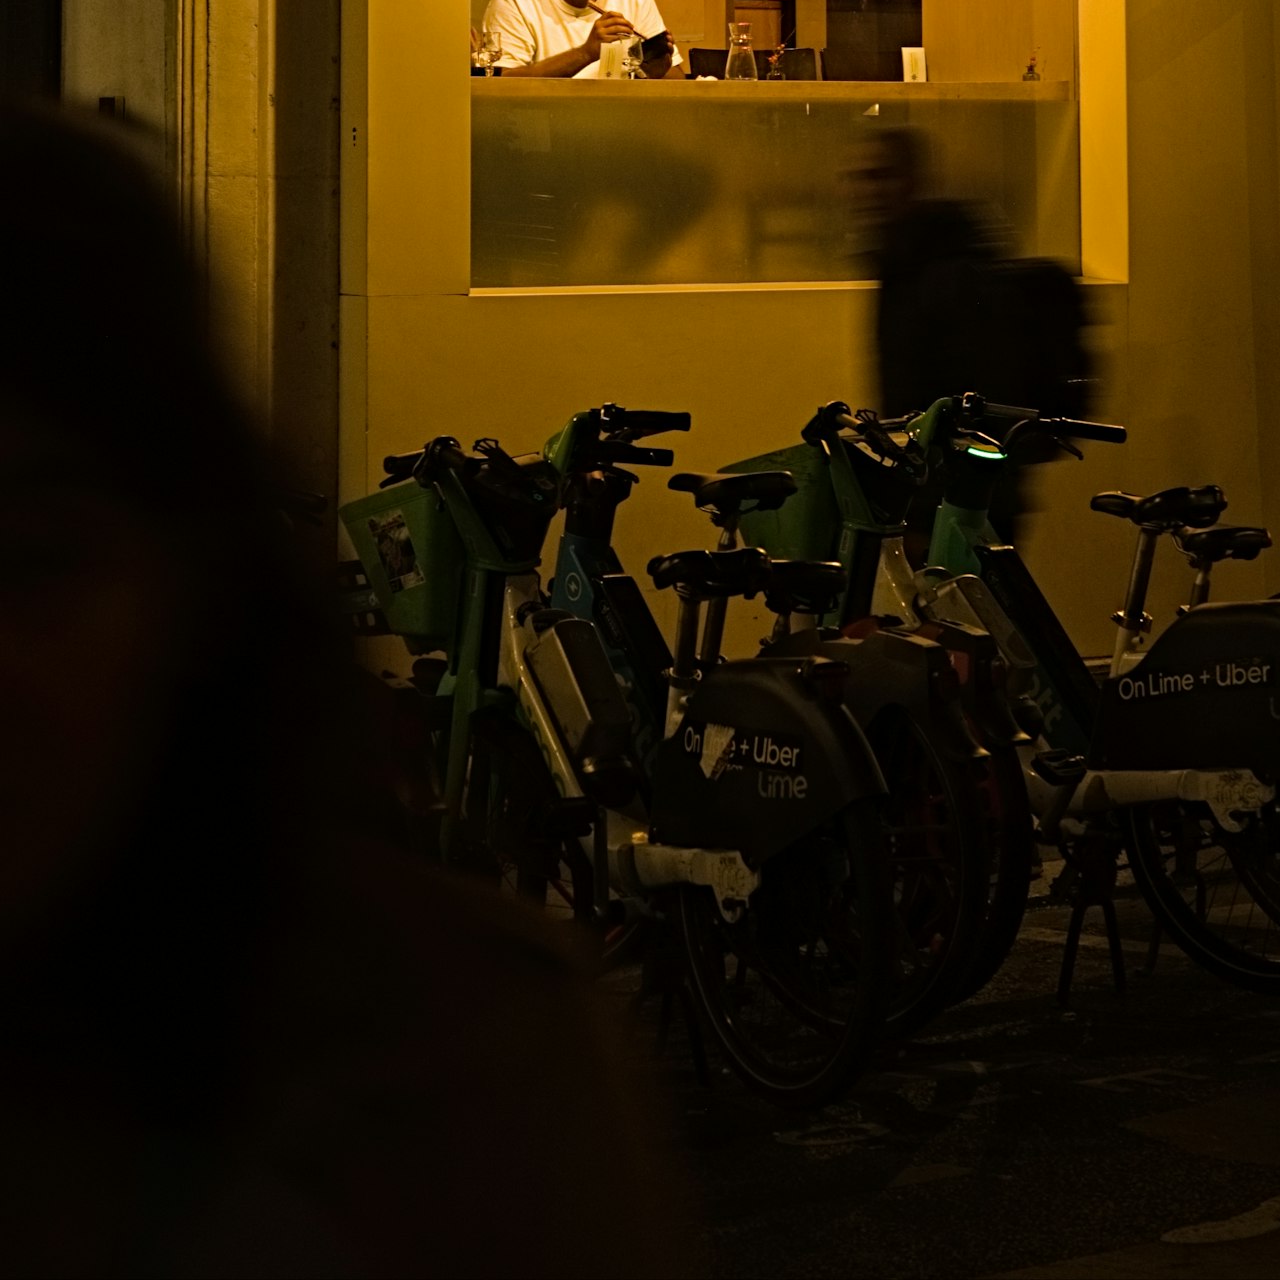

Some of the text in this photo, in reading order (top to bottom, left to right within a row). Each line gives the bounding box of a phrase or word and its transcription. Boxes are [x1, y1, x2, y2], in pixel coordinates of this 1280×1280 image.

[1118, 677, 1146, 701] On
[1148, 672, 1195, 696] Lime
[1215, 663, 1271, 687] Uber
[684, 725, 702, 754] On
[753, 735, 801, 768] Uber
[757, 770, 809, 800] Lime
